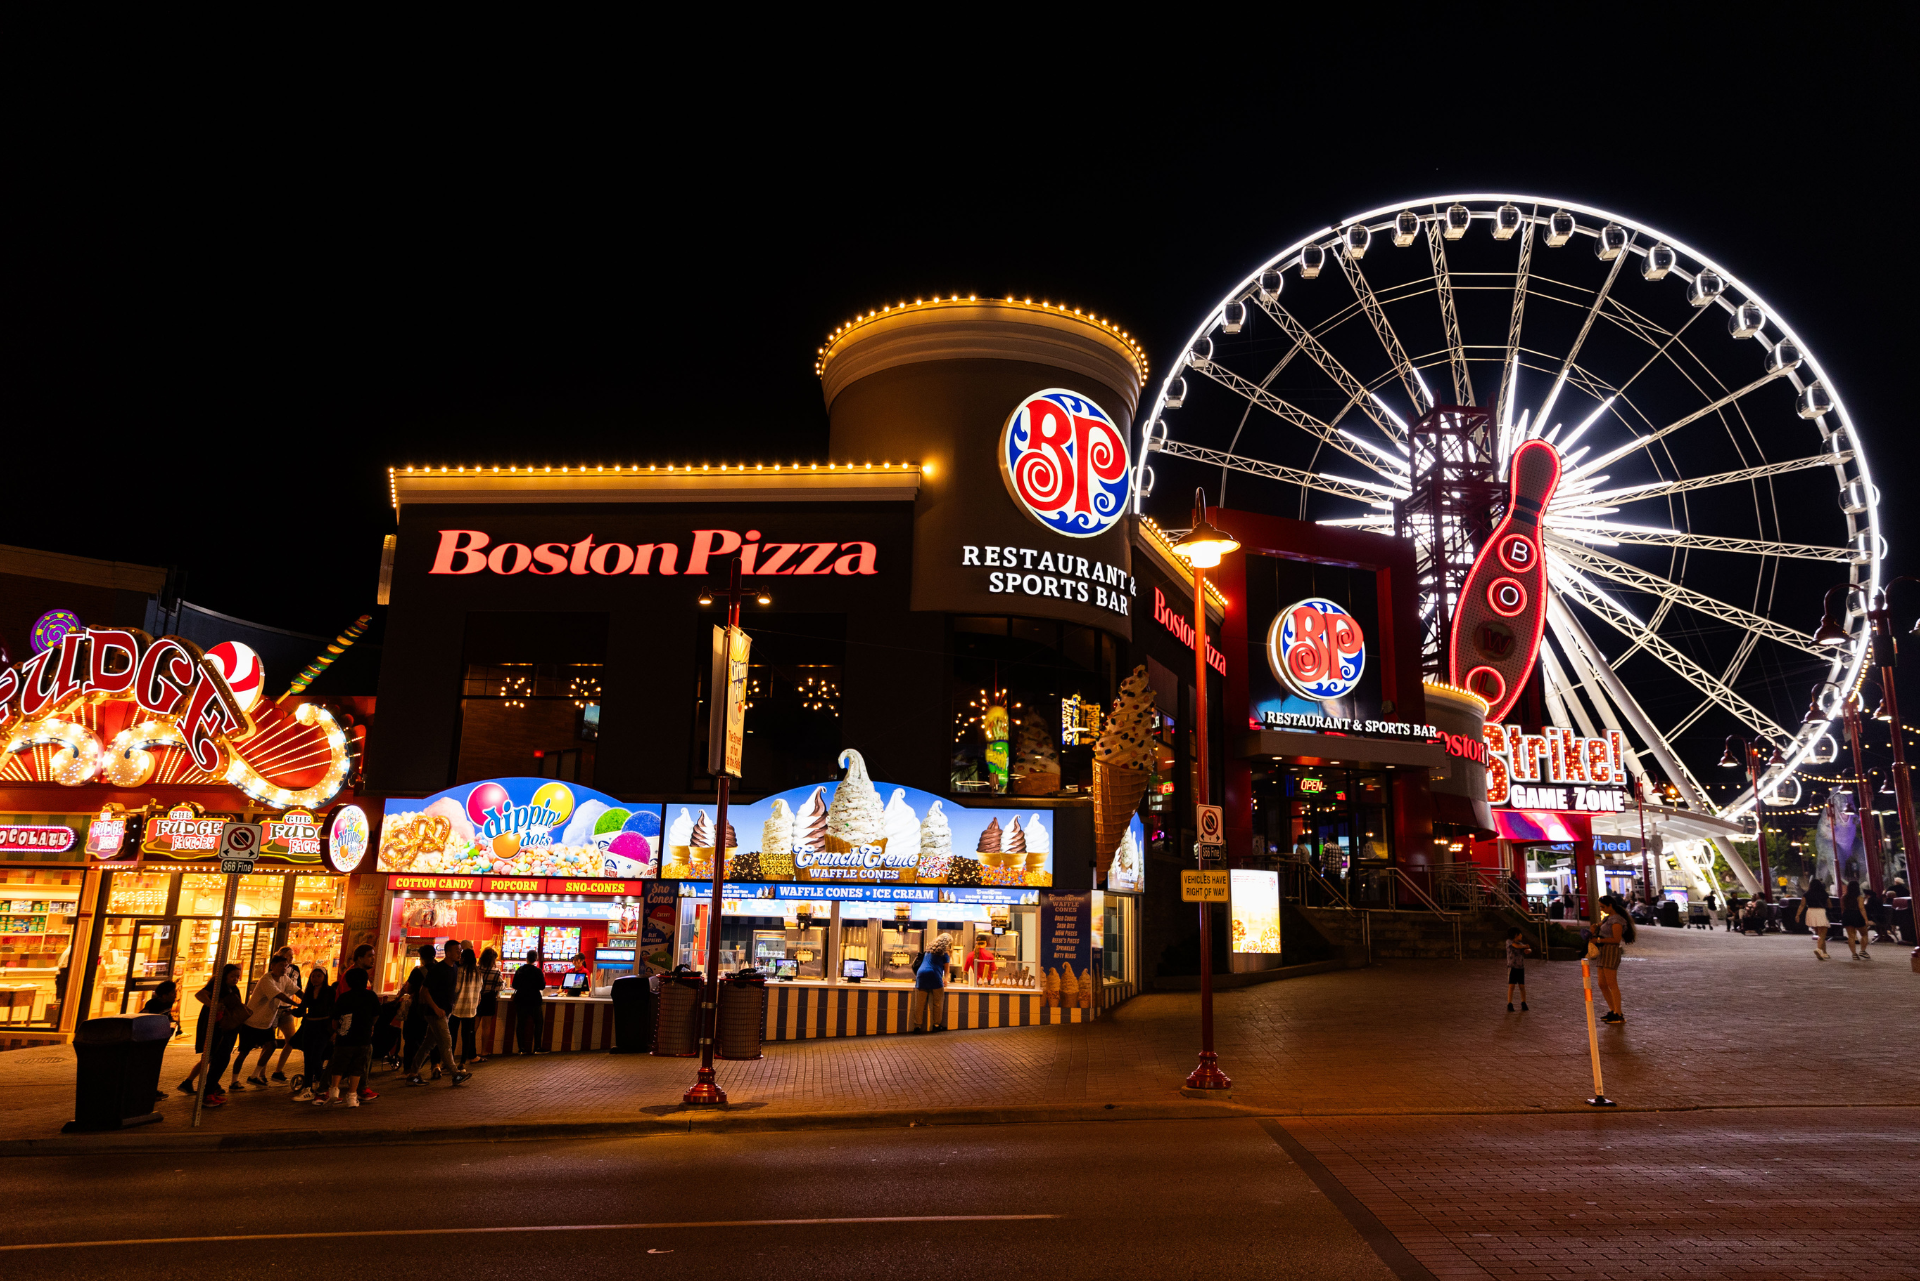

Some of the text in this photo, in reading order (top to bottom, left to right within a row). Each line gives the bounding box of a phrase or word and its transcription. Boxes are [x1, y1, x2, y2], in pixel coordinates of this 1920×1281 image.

[1015, 399, 1126, 516] BP
[428, 529, 879, 575] Boston Pizza
[962, 545, 1137, 597] RESTAURANT &
[989, 571, 1129, 616] SPORTS BAR
[1290, 606, 1364, 683] BP
[1205, 633, 1227, 677] izza
[1267, 711, 1437, 738] RESTAURANT & SPORTS BAR
[1301, 780, 1323, 792] OPEN
[1511, 784, 1625, 812] GAME ZONE
[484, 798, 561, 838] dippin'
[92, 820, 124, 837] FUDGE
[155, 820, 223, 837] FUDGE
[171, 836, 216, 851] FACTORY
[520, 831, 550, 847] dots
[1210, 846, 1220, 857] Fine
[222, 861, 252, 873] $66 Fine
[809, 868, 900, 880] WAFFLE CONES
[395, 878, 474, 890] COTTON CANDY
[491, 881, 538, 891] POPCORN
[1184, 875, 1211, 885] VEHICLES
[1211, 876, 1227, 885] HAVE
[565, 883, 625, 893] SNO-CONES
[651, 882, 670, 894] Sno
[780, 886, 934, 900] WAFFLE CONES ICE CREAM
[1186, 887, 1225, 897] RIGHT OF WAY
[647, 893, 674, 904] Cones
